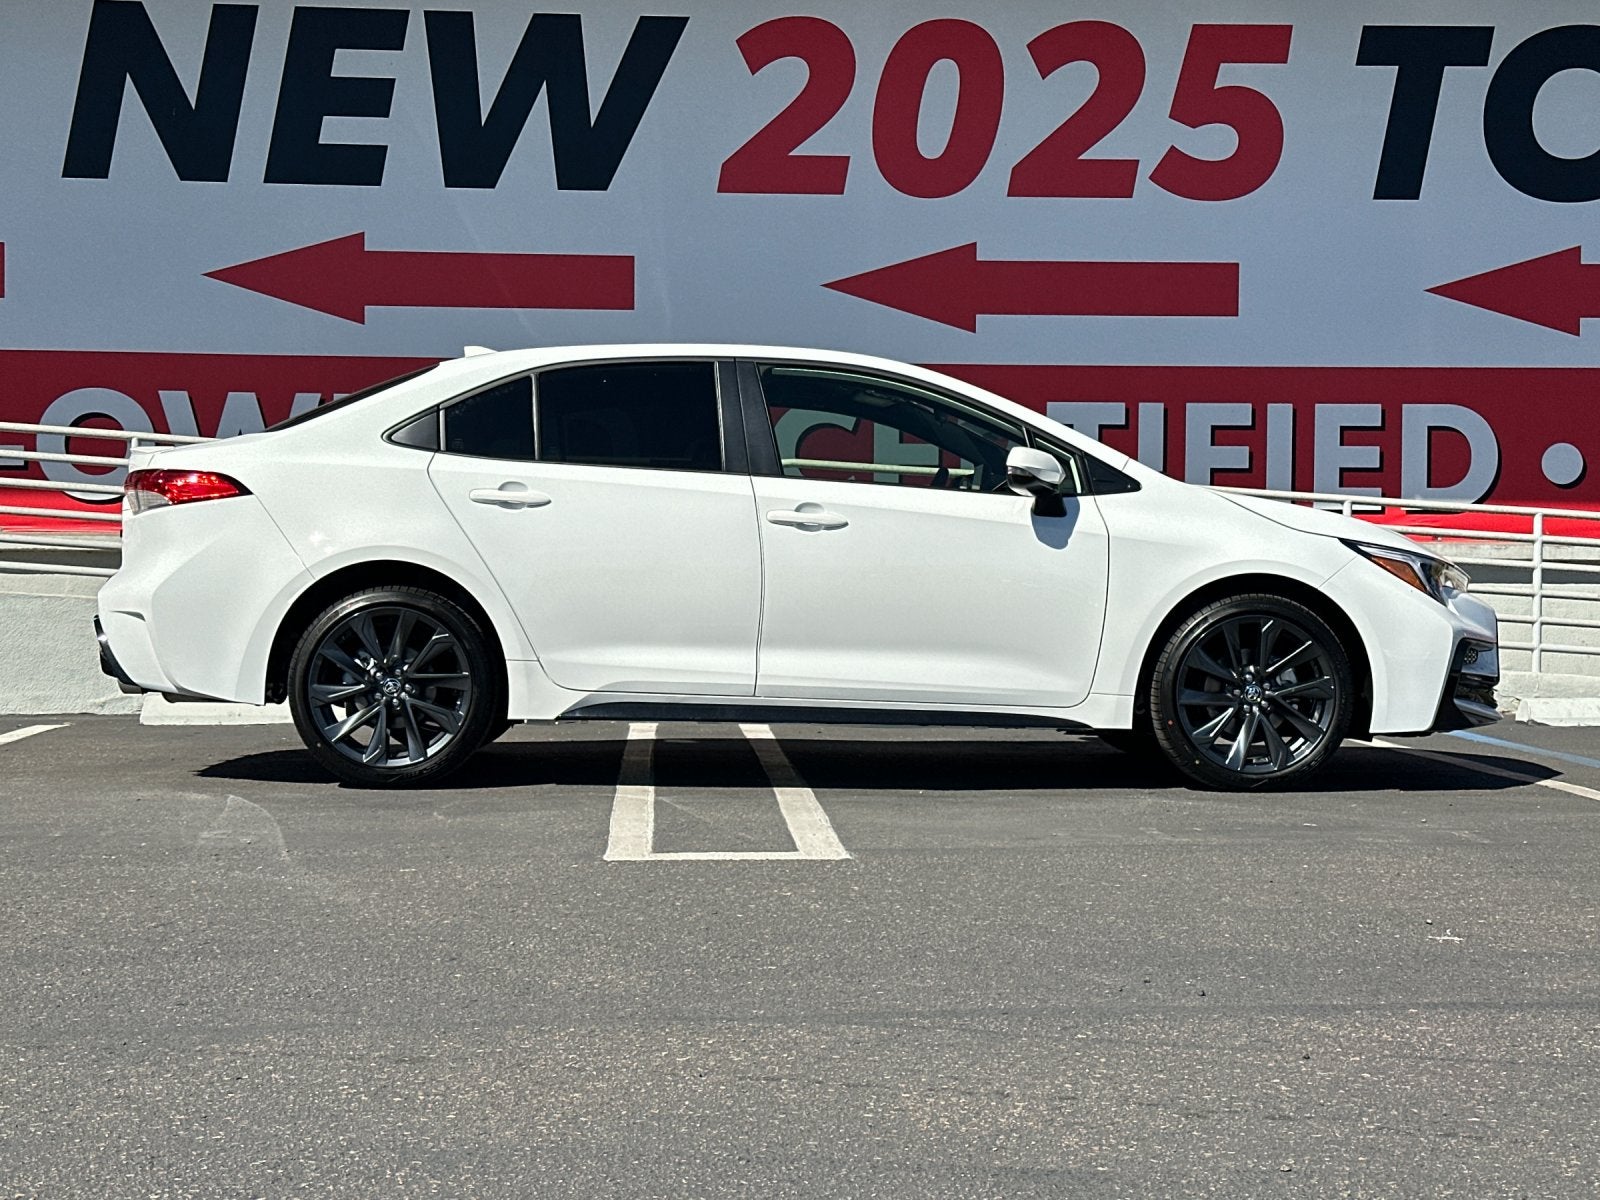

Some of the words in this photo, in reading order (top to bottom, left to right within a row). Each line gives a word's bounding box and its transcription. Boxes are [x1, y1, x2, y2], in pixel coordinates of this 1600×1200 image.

[61, 0, 690, 191] NEW
[717, 16, 1293, 201] 2025
[1355, 24, 1600, 203] TO
[774, 401, 1502, 514] CETIFIED
